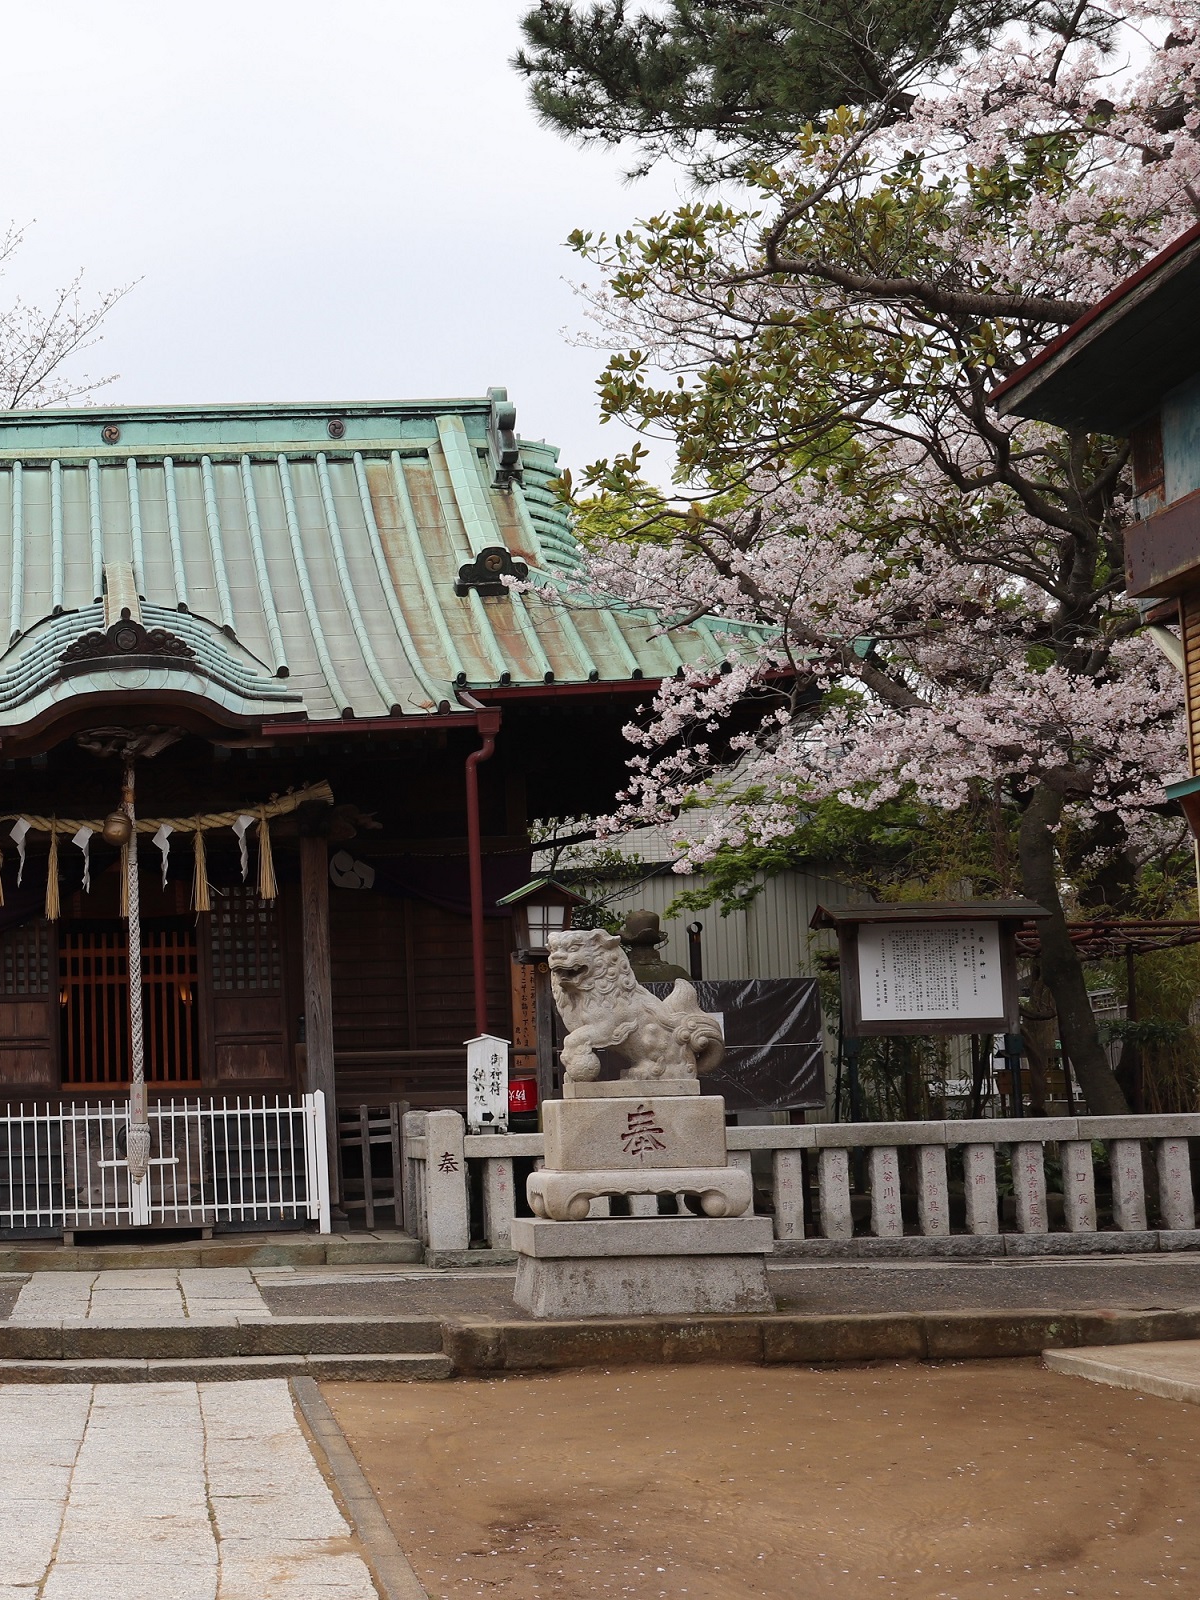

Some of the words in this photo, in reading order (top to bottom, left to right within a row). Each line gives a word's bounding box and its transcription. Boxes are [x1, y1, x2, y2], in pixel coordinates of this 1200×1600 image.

[515, 1026, 523, 1067] 鹿島社
[620, 1104, 666, 1161] 奉
[437, 1151, 459, 1174] 奉
